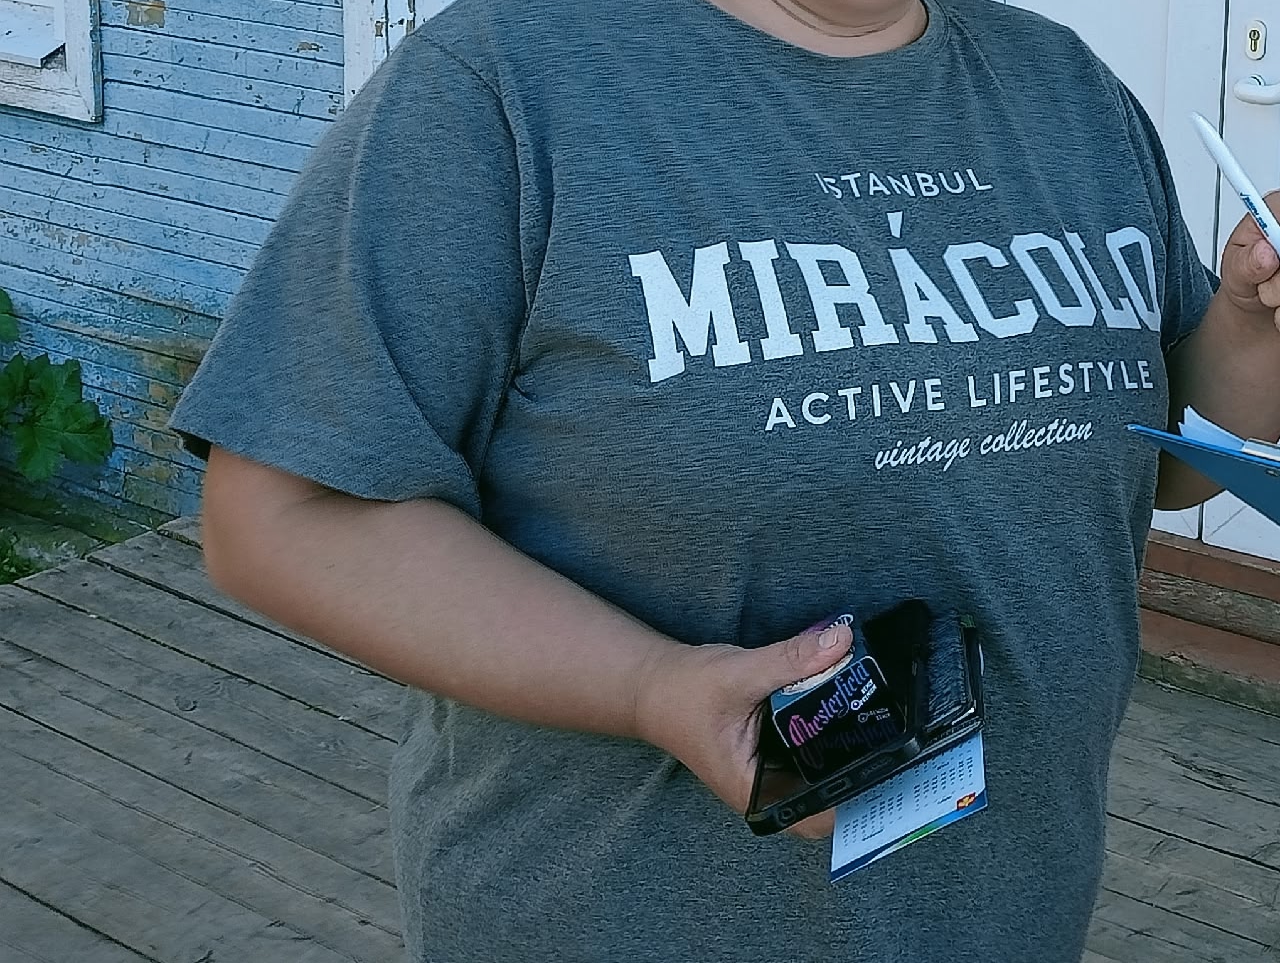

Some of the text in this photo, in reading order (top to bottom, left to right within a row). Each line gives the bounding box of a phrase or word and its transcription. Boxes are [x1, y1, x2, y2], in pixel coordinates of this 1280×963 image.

[815, 169, 994, 199] ISTANBUL
[628, 211, 1161, 383] MIRÁCOLO
[764, 360, 1155, 431] ACTIVE LIFESTYLE
[873, 418, 1094, 472] vintage collection
[788, 660, 870, 748] Chesterfield
